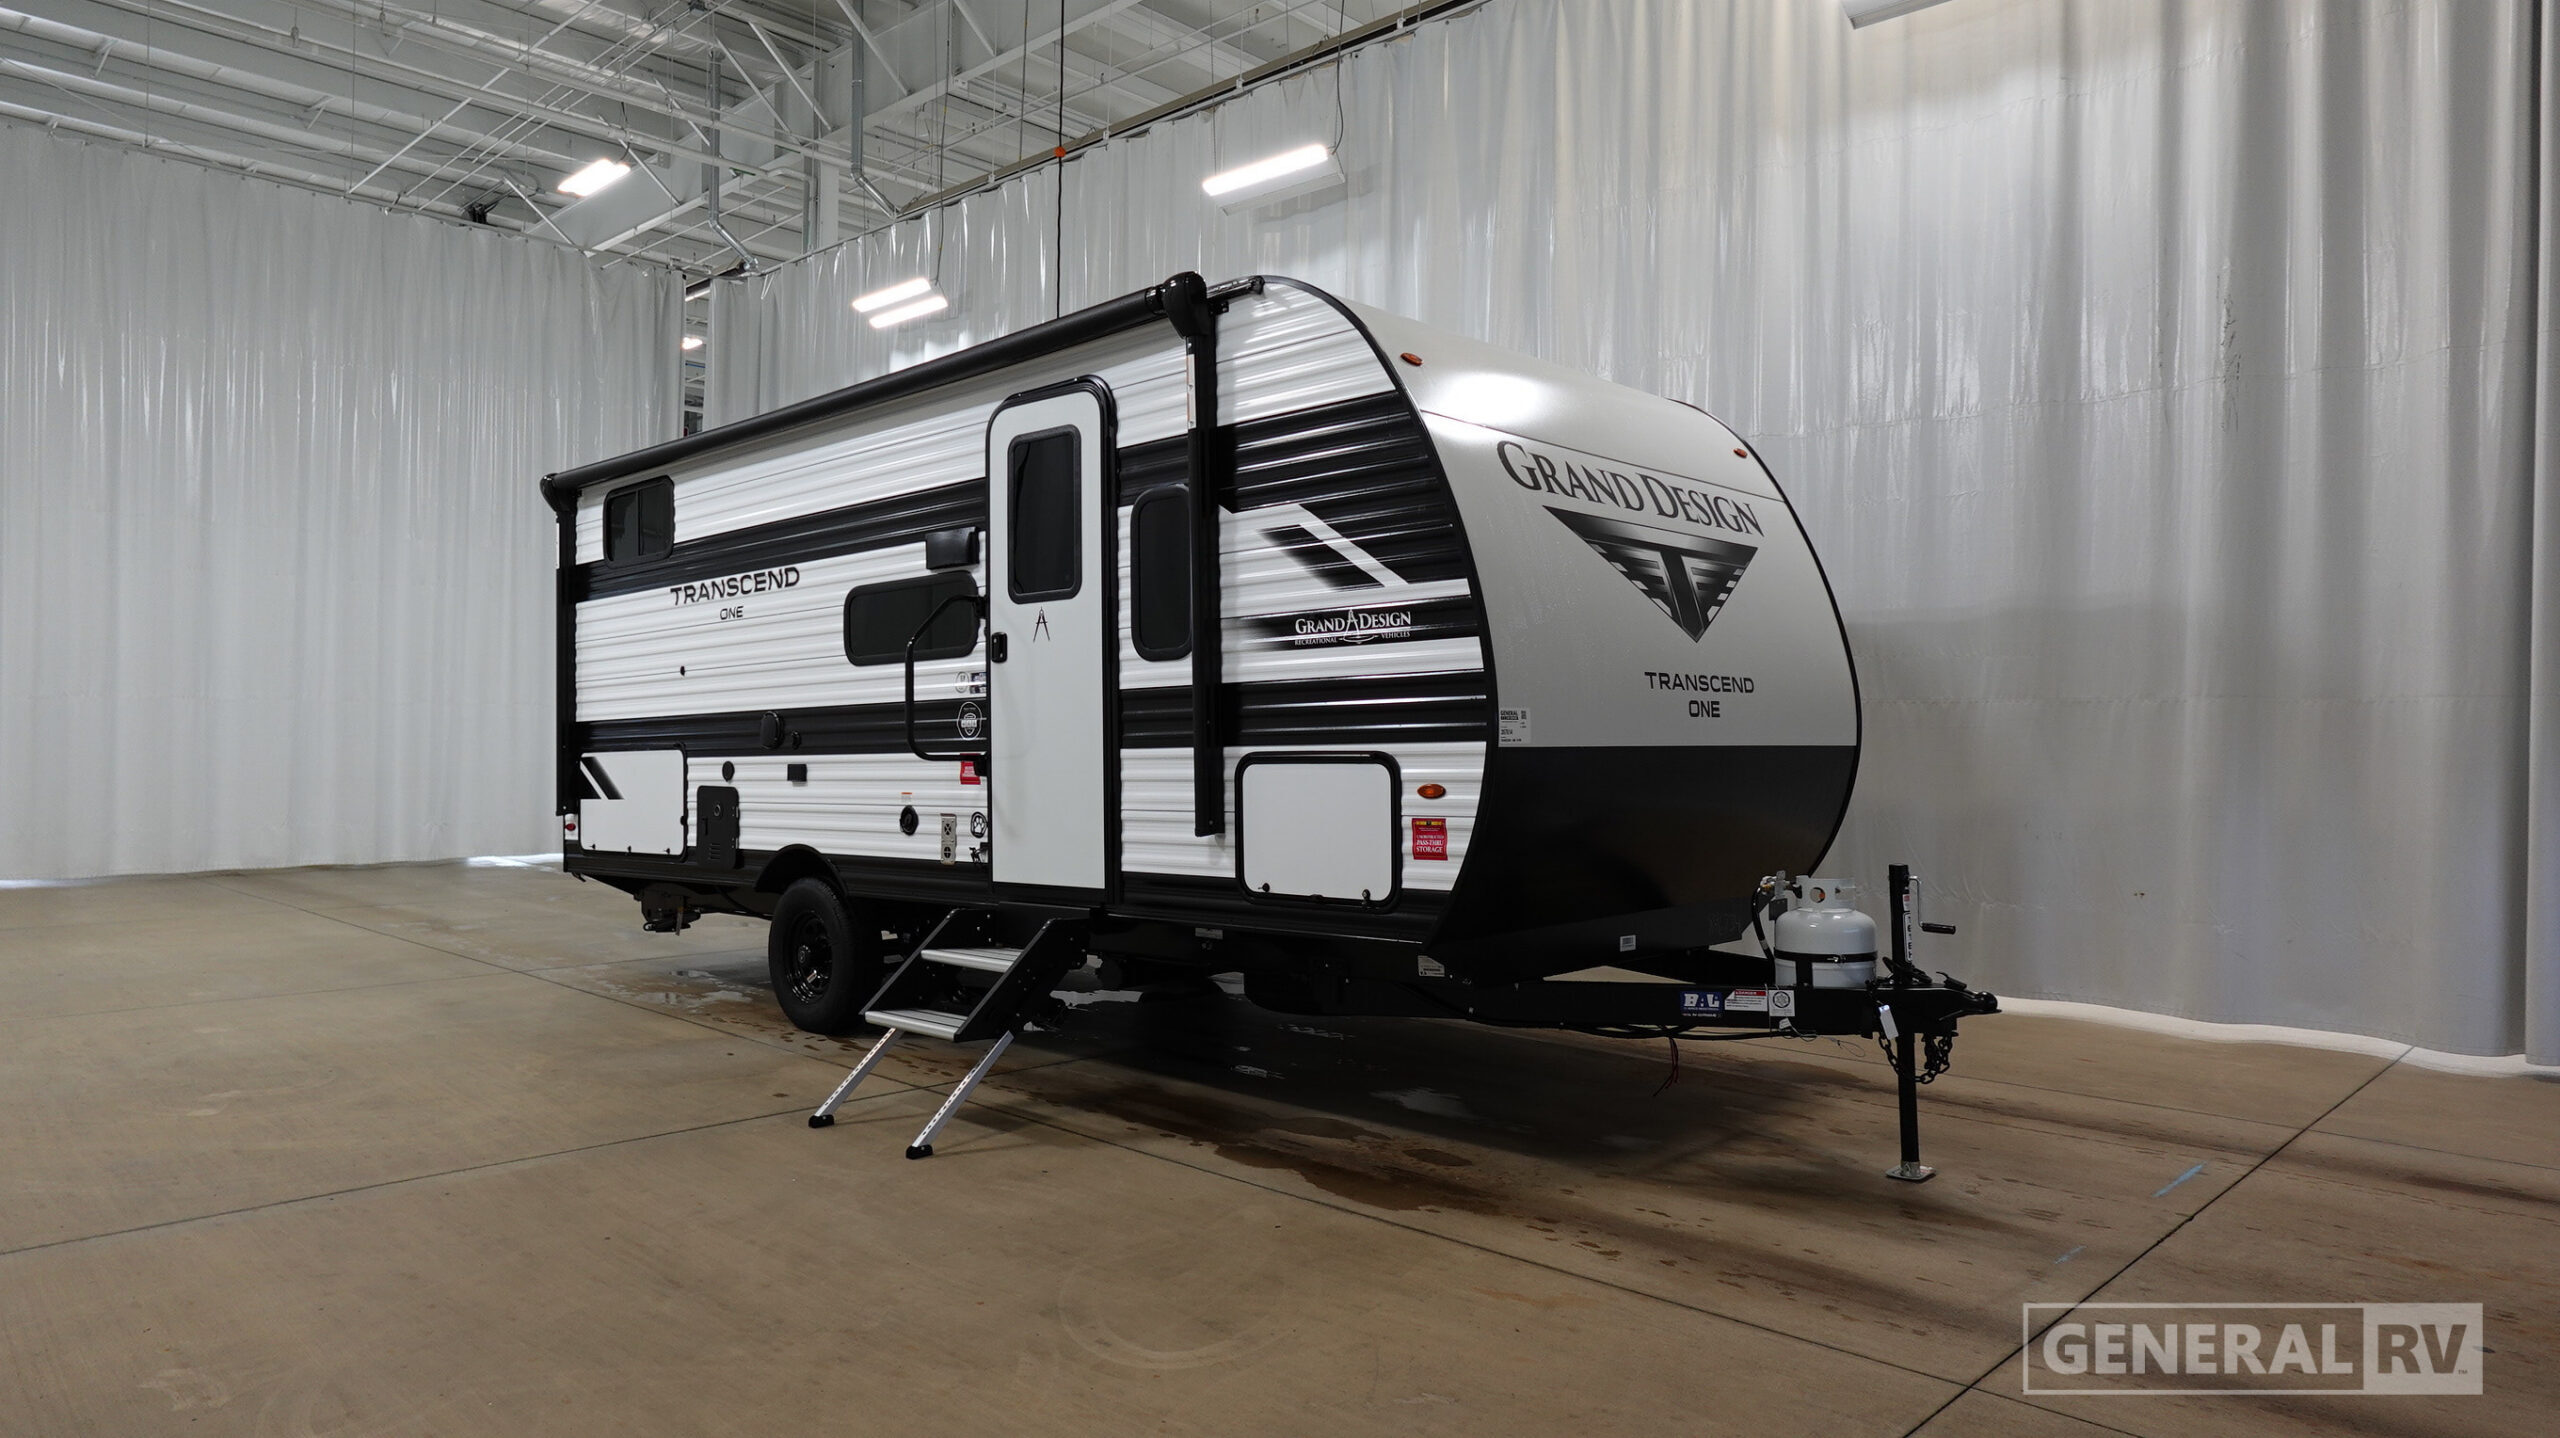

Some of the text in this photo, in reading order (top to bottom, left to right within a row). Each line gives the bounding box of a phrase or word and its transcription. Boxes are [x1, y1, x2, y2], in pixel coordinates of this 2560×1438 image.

[1496, 439, 1765, 537] GRAND DESIGN
[669, 566, 800, 606] TRANSCEND
[719, 605, 744, 620] ONE
[1380, 631, 1411, 639] VEHICLES
[1644, 671, 1755, 694] TRANSCEND
[1688, 700, 1721, 718] ONE
